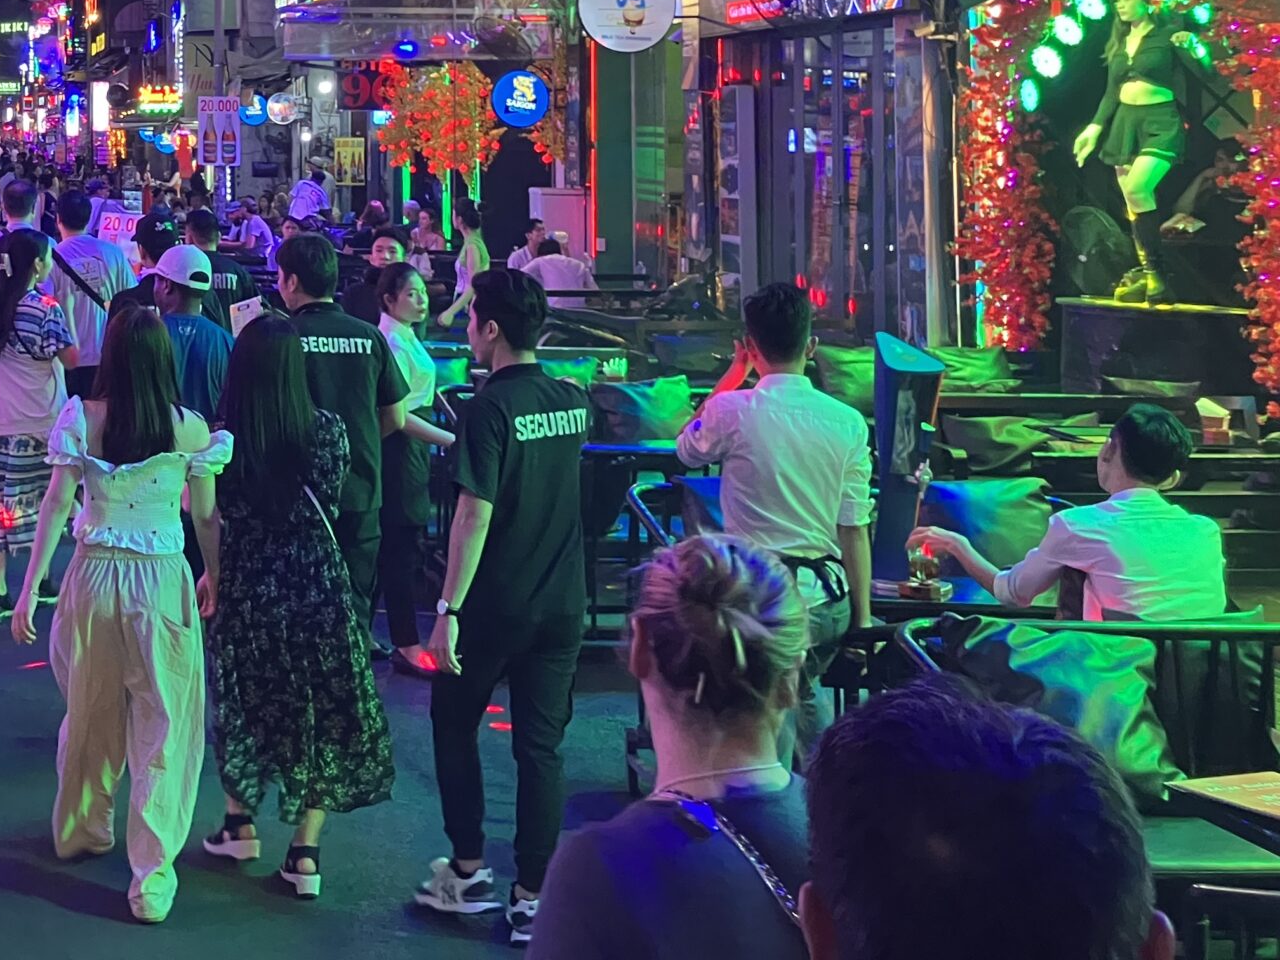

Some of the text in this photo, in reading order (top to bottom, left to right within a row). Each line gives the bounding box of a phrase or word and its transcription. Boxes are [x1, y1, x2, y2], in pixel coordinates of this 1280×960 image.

[200, 99, 239, 113] 20.000
[505, 97, 537, 111] SAIGON
[300, 336, 373, 355] SECURITY
[514, 408, 587, 442] SECURITY
